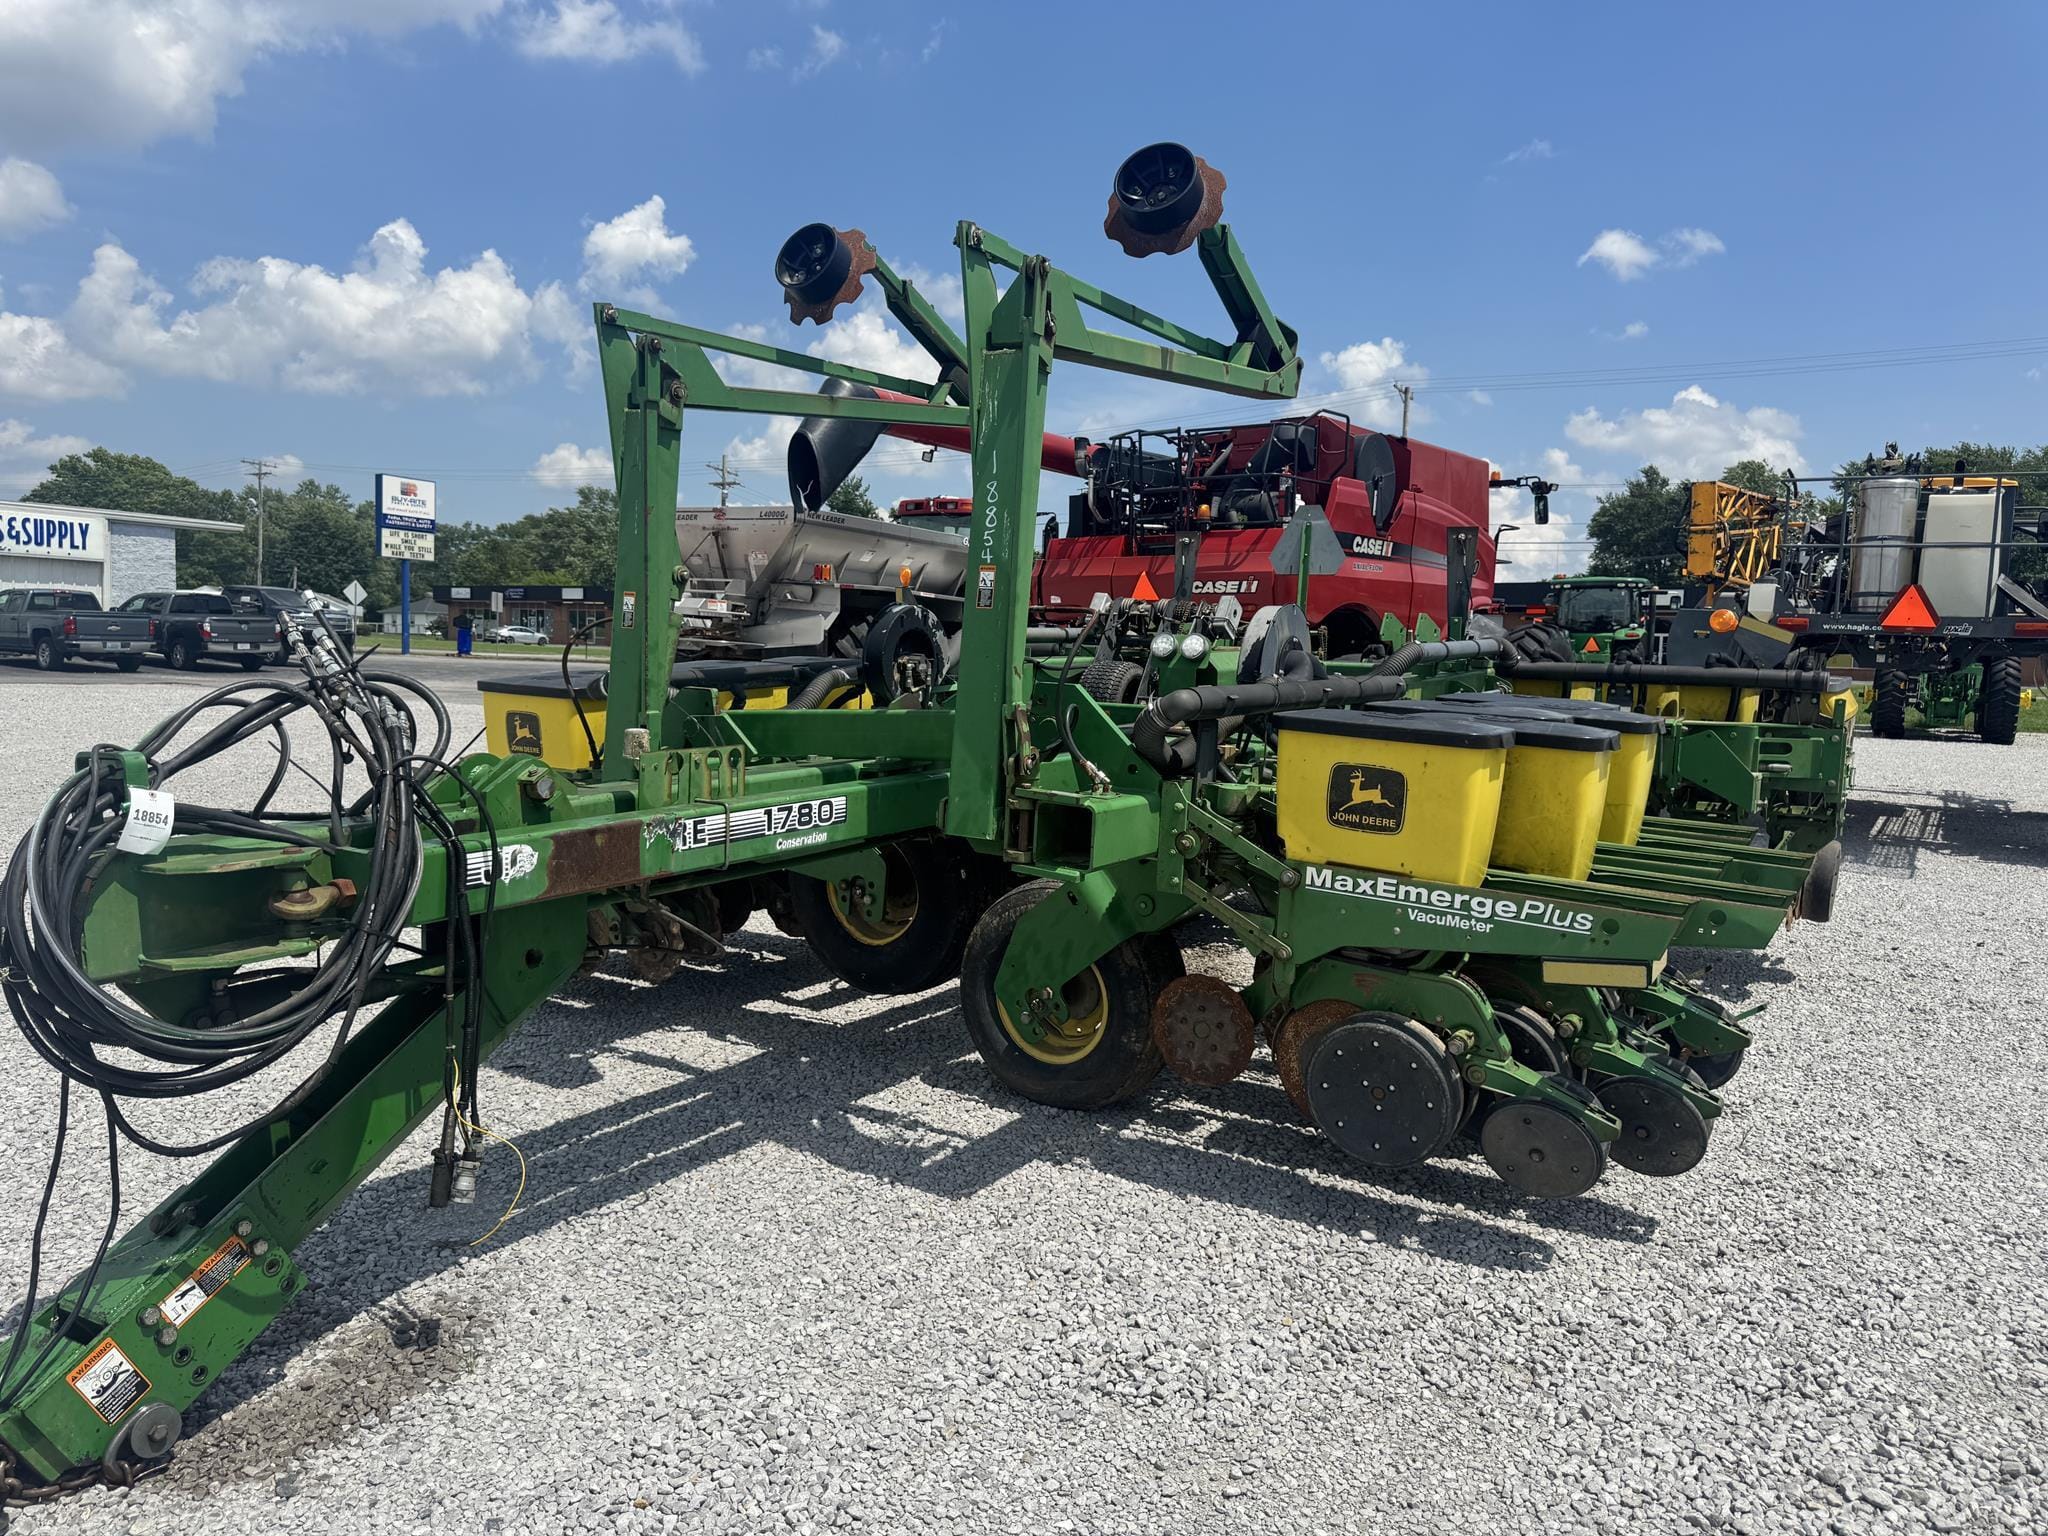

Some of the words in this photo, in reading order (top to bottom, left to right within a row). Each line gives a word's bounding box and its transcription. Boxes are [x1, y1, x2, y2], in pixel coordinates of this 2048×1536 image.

[980, 449, 999, 563] 18854
[822, 514, 846, 524] LEADER
[411, 531, 427, 540] SHORT
[384, 543, 401, 551] WHILE
[418, 546, 433, 554] STILL
[1823, 623, 1882, 632] www.hagie.co
[1943, 623, 1973, 635] HAGIE
[133, 808, 169, 827] 18854
[763, 799, 835, 835] 1780
[1332, 811, 1360, 823] JOHN
[1362, 815, 1397, 828] DEERE
[776, 832, 828, 850] Conservation
[1408, 908, 1494, 933] VacuMeter
[204, 1240, 235, 1269] WARNING
[78, 1341, 113, 1377] WARNING
